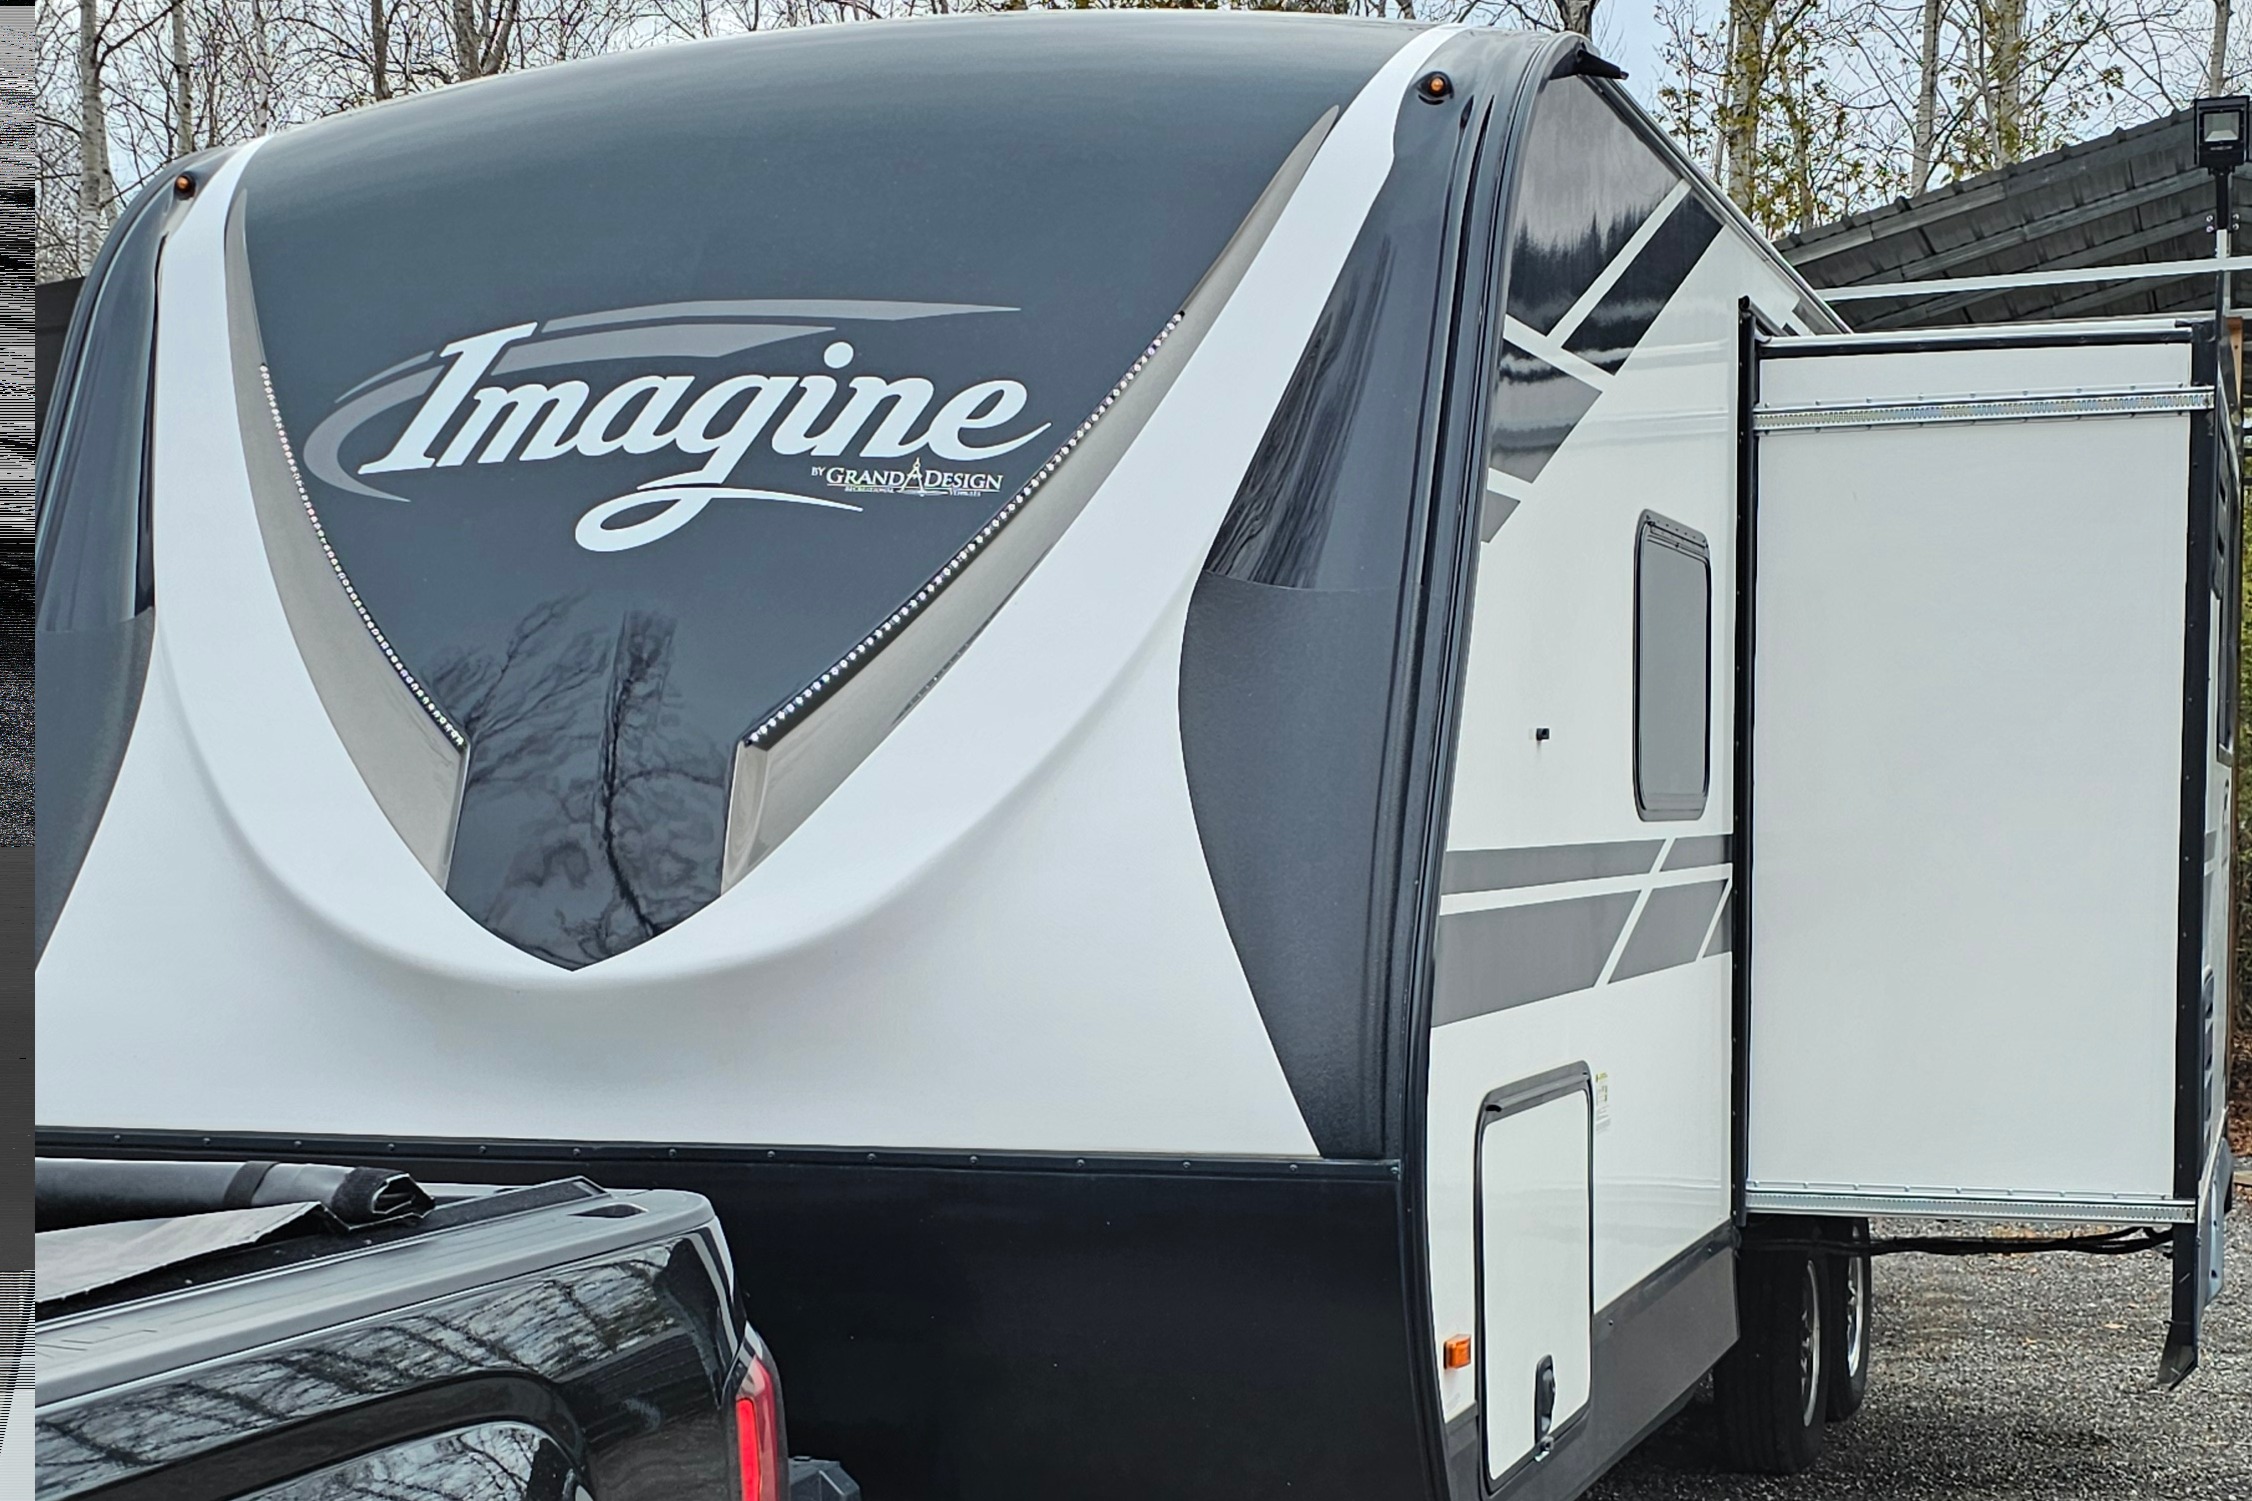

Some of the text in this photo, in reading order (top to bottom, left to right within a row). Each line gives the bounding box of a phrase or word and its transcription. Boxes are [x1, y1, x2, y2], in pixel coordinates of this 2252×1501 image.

[358, 322, 1052, 552] Imagine
[811, 466, 1004, 490] BY GRAND DESIGN
